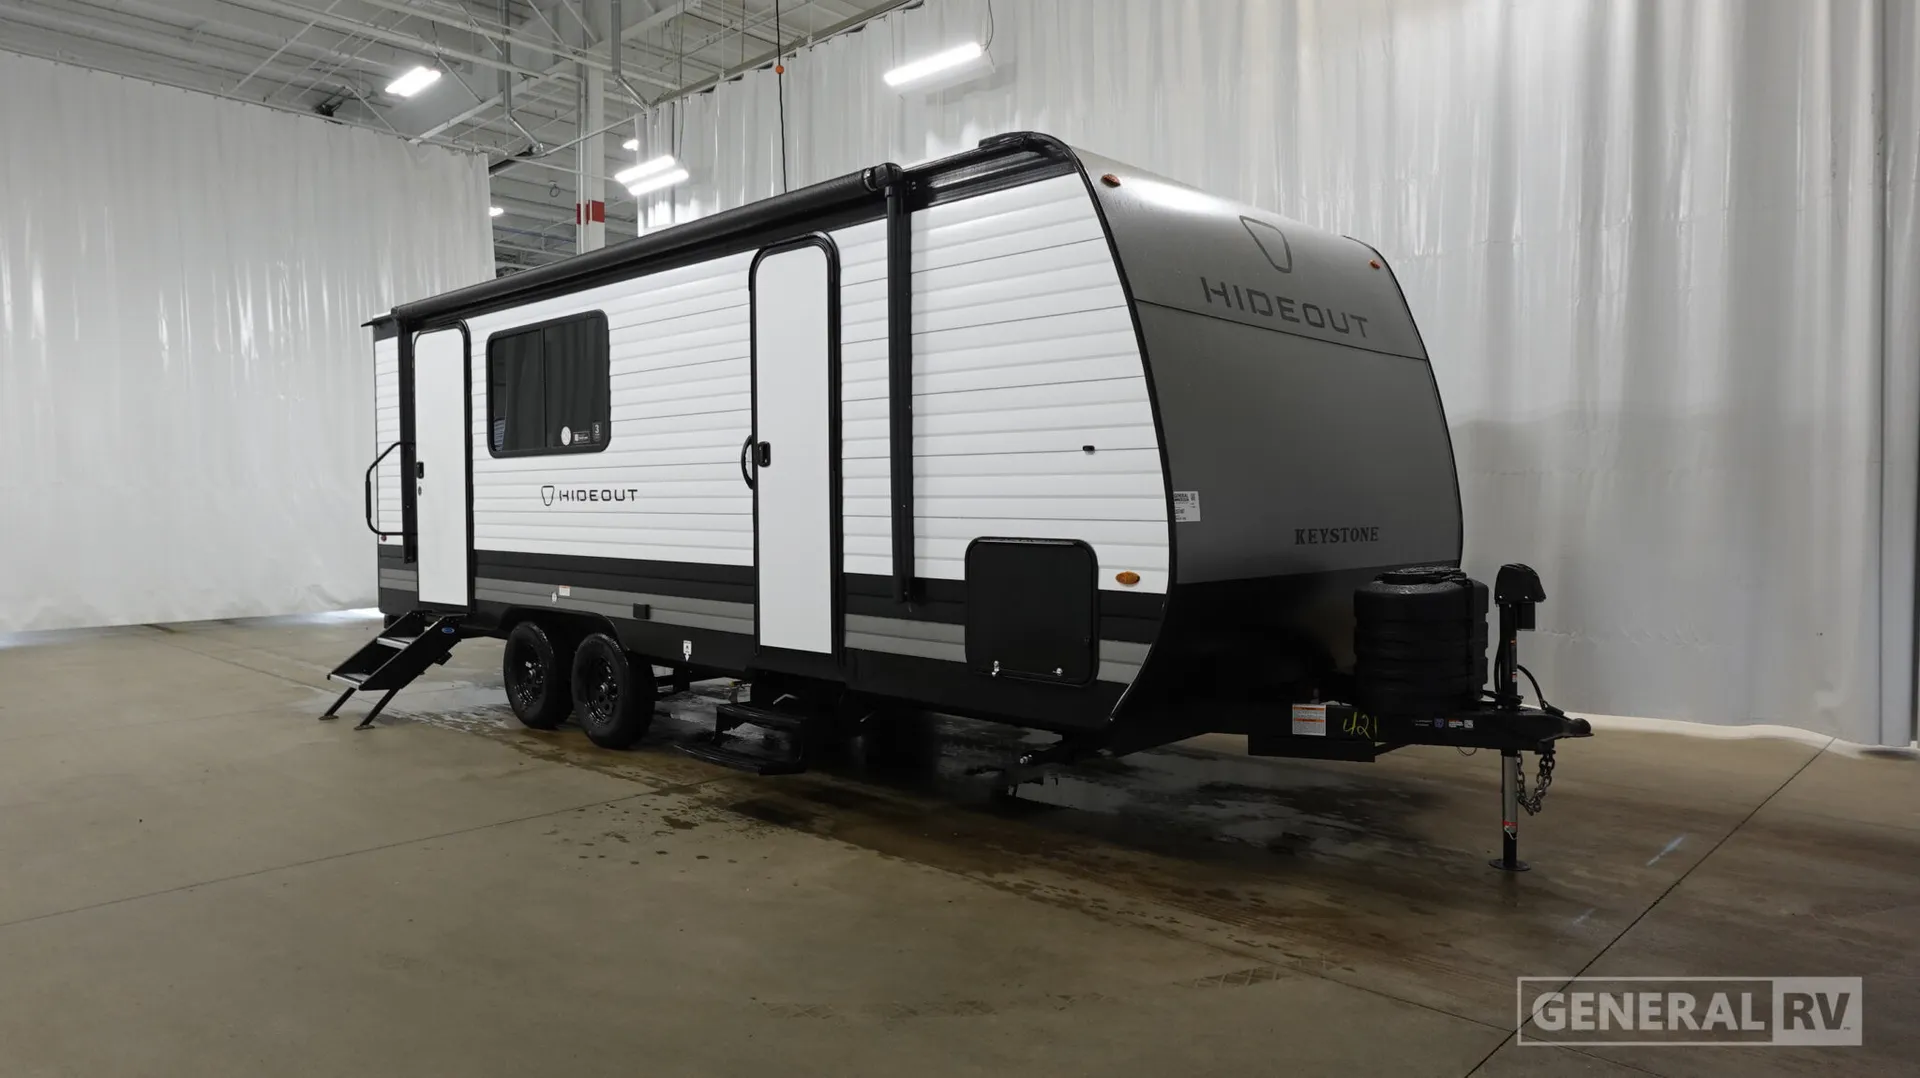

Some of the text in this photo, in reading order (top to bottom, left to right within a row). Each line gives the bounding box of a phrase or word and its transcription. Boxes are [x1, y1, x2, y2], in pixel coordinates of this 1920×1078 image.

[1200, 276, 1368, 338] HIDEOUT
[559, 489, 638, 502] HIDEOUT
[1294, 527, 1380, 545] KEYSTONE
[1342, 711, 1378, 739] 421
